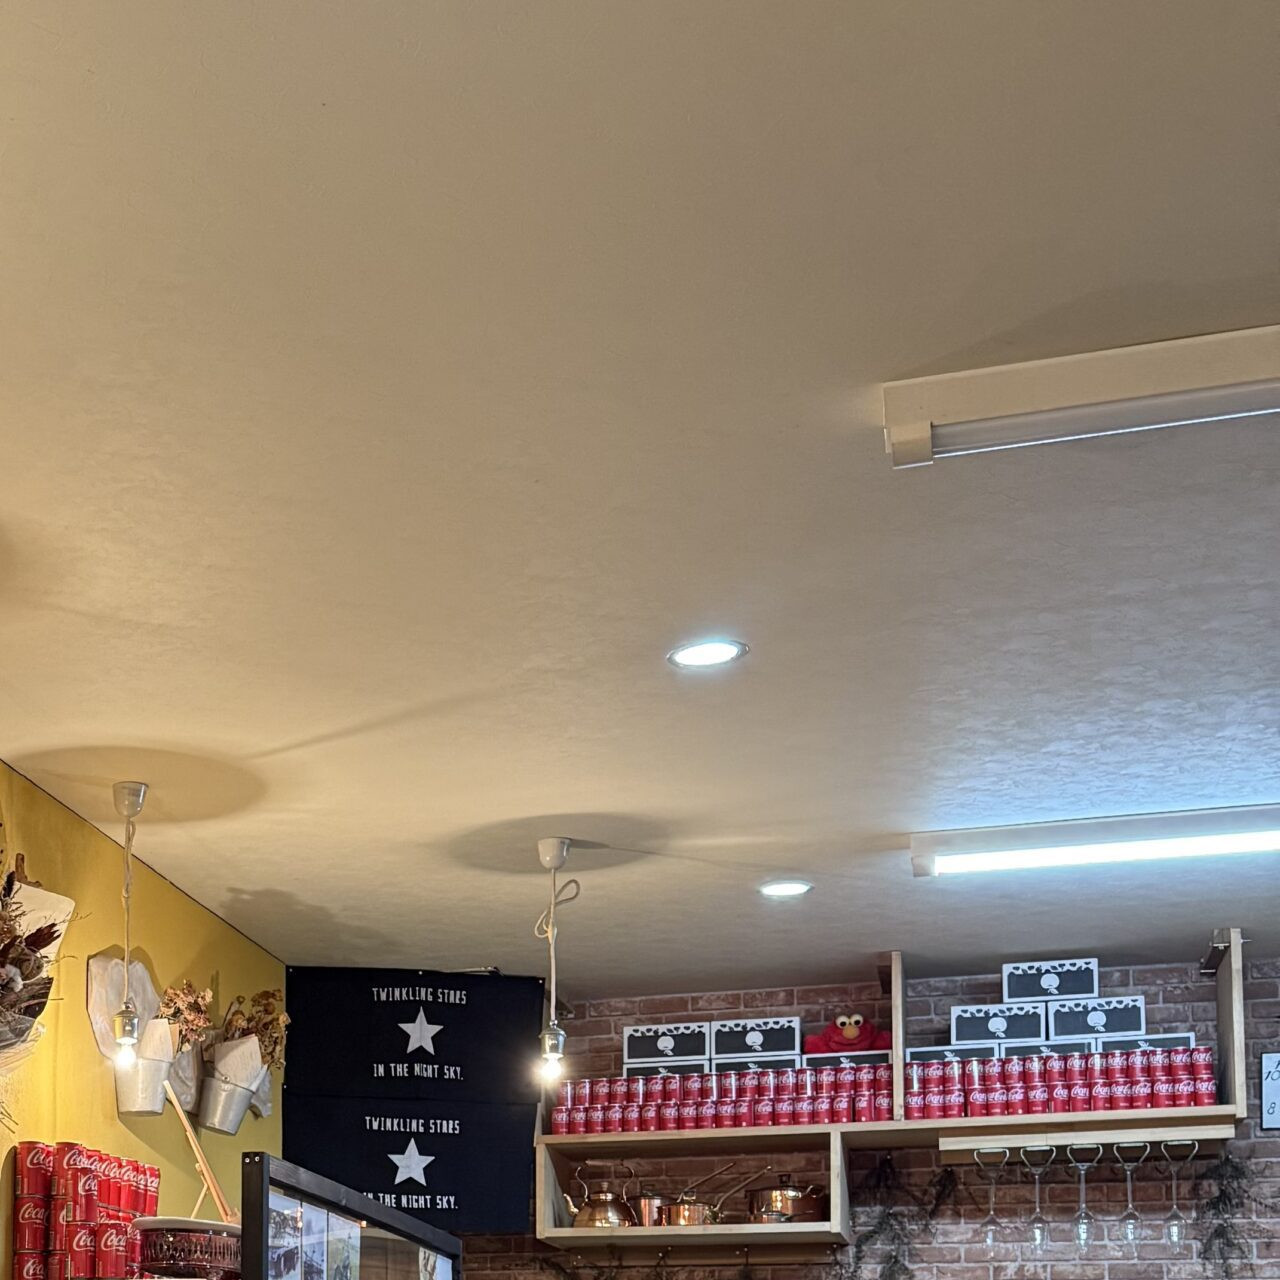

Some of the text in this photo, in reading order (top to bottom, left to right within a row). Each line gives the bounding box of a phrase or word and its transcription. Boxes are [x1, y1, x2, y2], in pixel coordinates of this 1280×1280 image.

[372, 987, 467, 1005] TWINKLING STARS
[373, 1063, 464, 1080] IN THE NIGHT SKY.
[365, 1116, 460, 1134] TWINKLING STARS
[401, 1194, 431, 1209] NIGHT
[436, 1196, 459, 1209] SKY.
